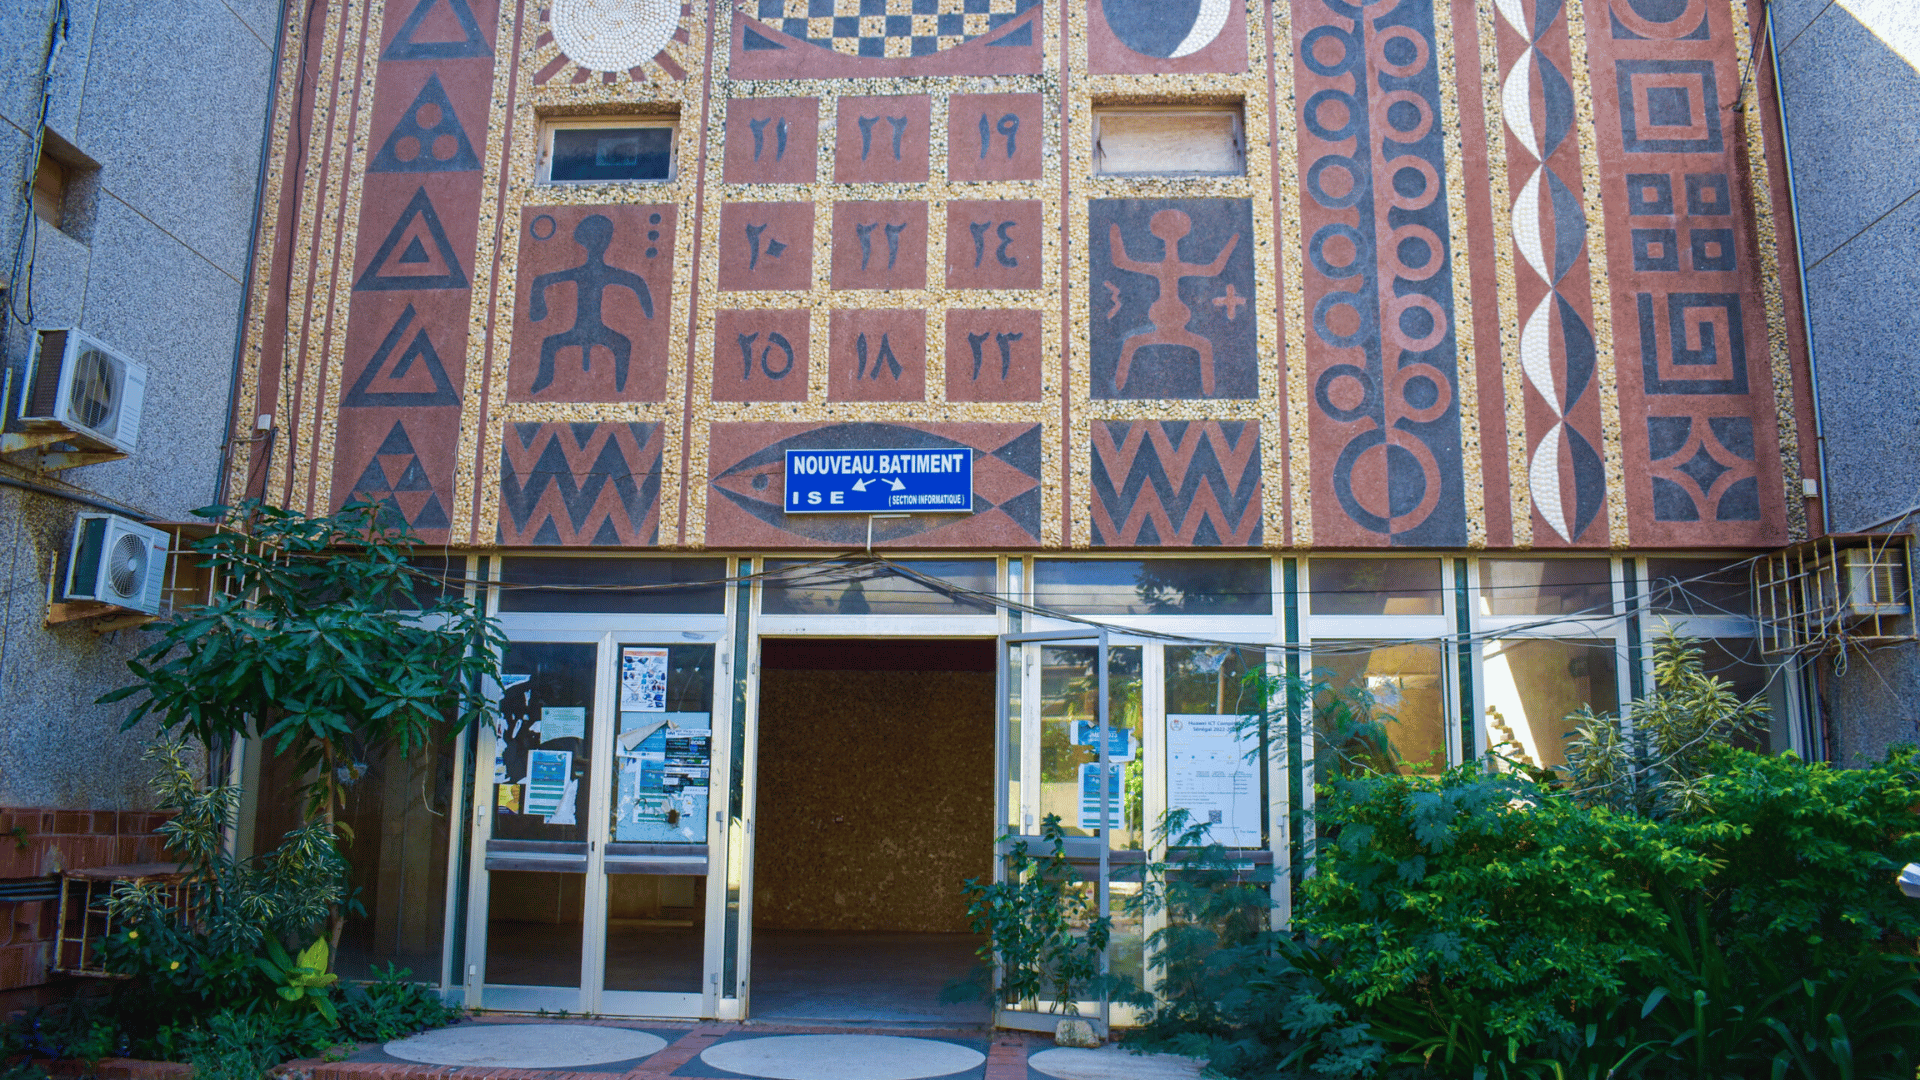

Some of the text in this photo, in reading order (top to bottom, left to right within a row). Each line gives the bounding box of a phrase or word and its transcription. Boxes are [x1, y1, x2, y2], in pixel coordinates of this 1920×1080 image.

[750, 117, 788, 162] ٢١
[979, 112, 1020, 160] ١٩
[746, 222, 788, 271] ٢٠
[970, 220, 1019, 269] ٢٤
[856, 332, 903, 381] ١٨
[879, 454, 964, 474] BATIMENT
